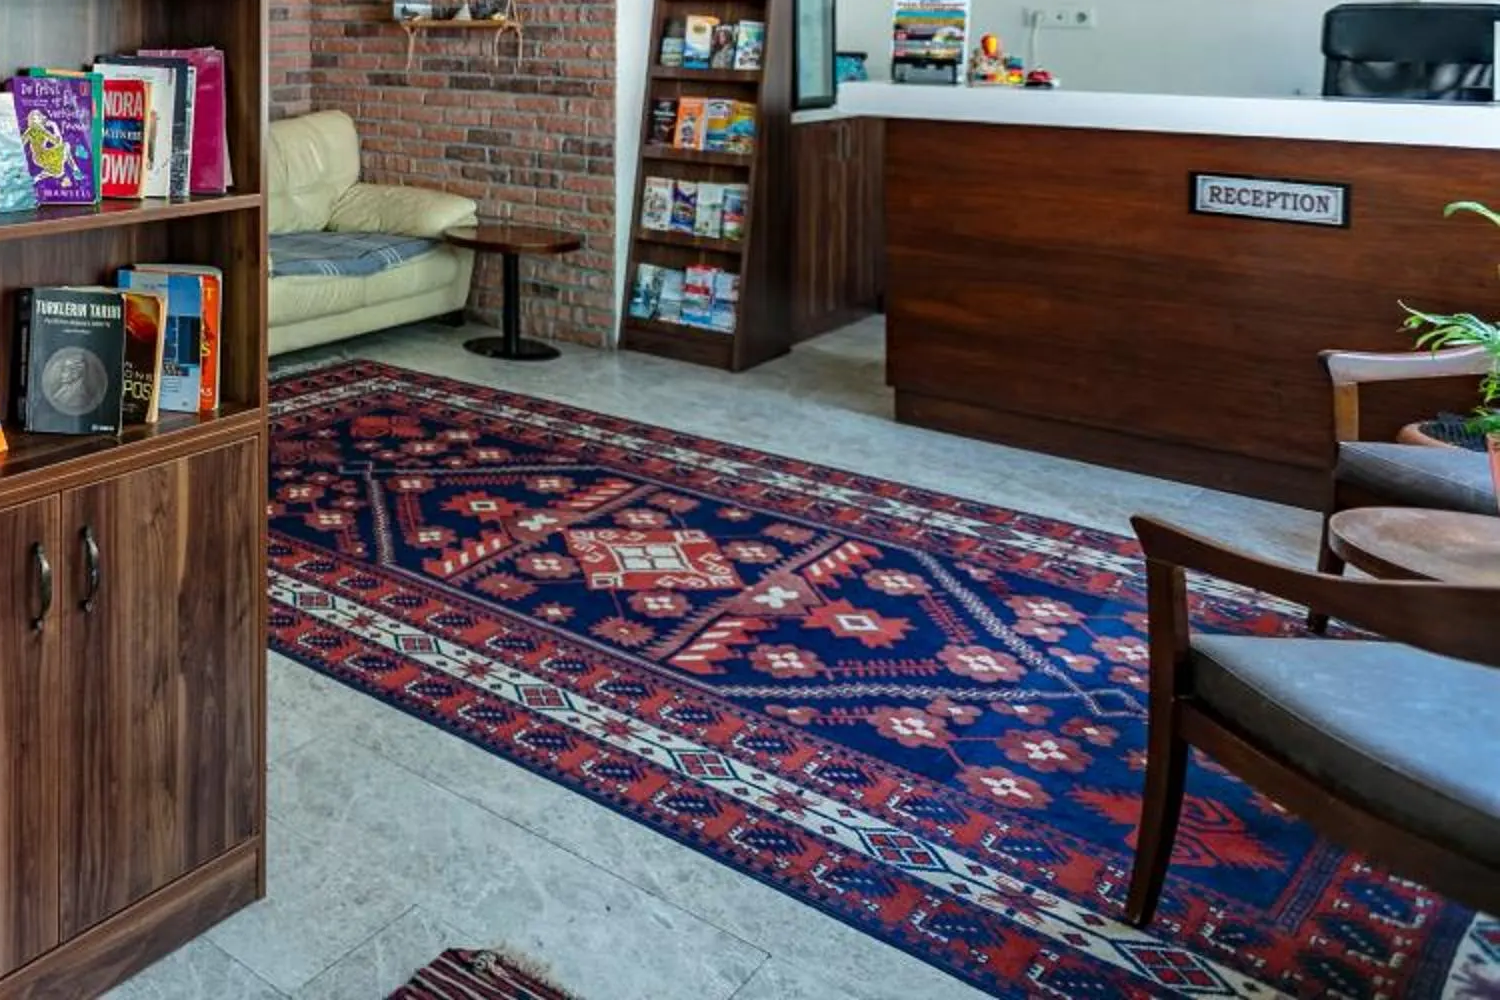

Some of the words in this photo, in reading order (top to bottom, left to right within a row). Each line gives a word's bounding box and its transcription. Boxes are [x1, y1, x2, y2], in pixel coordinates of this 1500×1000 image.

[102, 90, 144, 120] NDRA
[100, 153, 140, 186] OWN
[1208, 185, 1331, 214] RECEPTION
